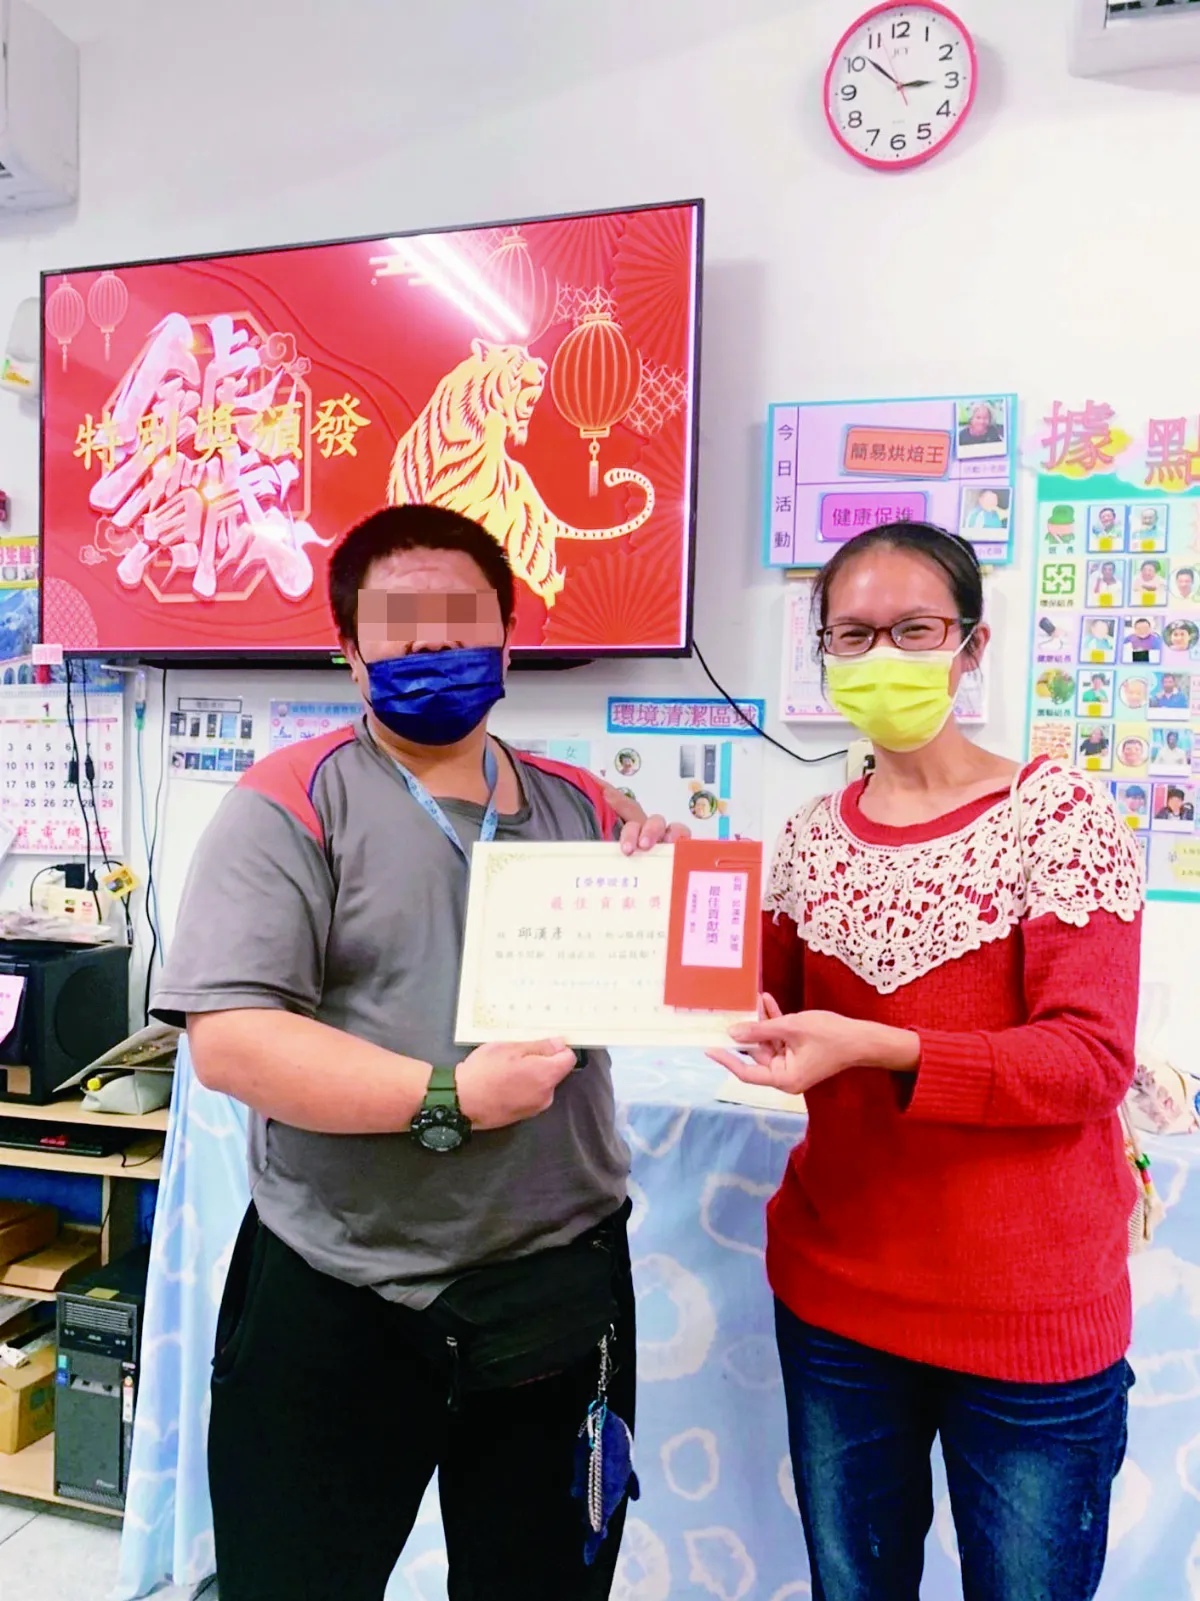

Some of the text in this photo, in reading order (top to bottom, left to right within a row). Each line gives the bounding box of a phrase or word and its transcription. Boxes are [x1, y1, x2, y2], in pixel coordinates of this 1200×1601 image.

[891, 21, 910, 39] 12
[925, 26, 929, 42] 1
[868, 33, 881, 49] 11
[939, 44, 953, 61] 2
[847, 56, 866, 73] 10
[944, 72, 959, 89] 3
[841, 85, 857, 101] 9
[936, 100, 951, 117] 4
[848, 110, 862, 128] 8
[866, 129, 880, 146] 7
[917, 123, 932, 140] 5
[890, 134, 906, 150] 6
[73, 393, 371, 471] 特別獎頒發
[850, 442, 945, 465] 簡易烘焙王
[774, 424, 794, 549] 今日活動
[42, 703, 49, 717] 1
[612, 703, 757, 728] 環境清潔區域
[6, 762, 17, 770] 10
[25, 762, 35, 770] 11
[44, 762, 55, 770] 12
[103, 761, 114, 770] 15
[6, 781, 17, 789] 17
[25, 781, 36, 789] 18
[44, 781, 56, 789] 19
[102, 781, 114, 789] 22
[24, 799, 36, 807] 25
[43, 799, 56, 807] 26
[63, 799, 74, 807] 27
[101, 799, 114, 808] 29
